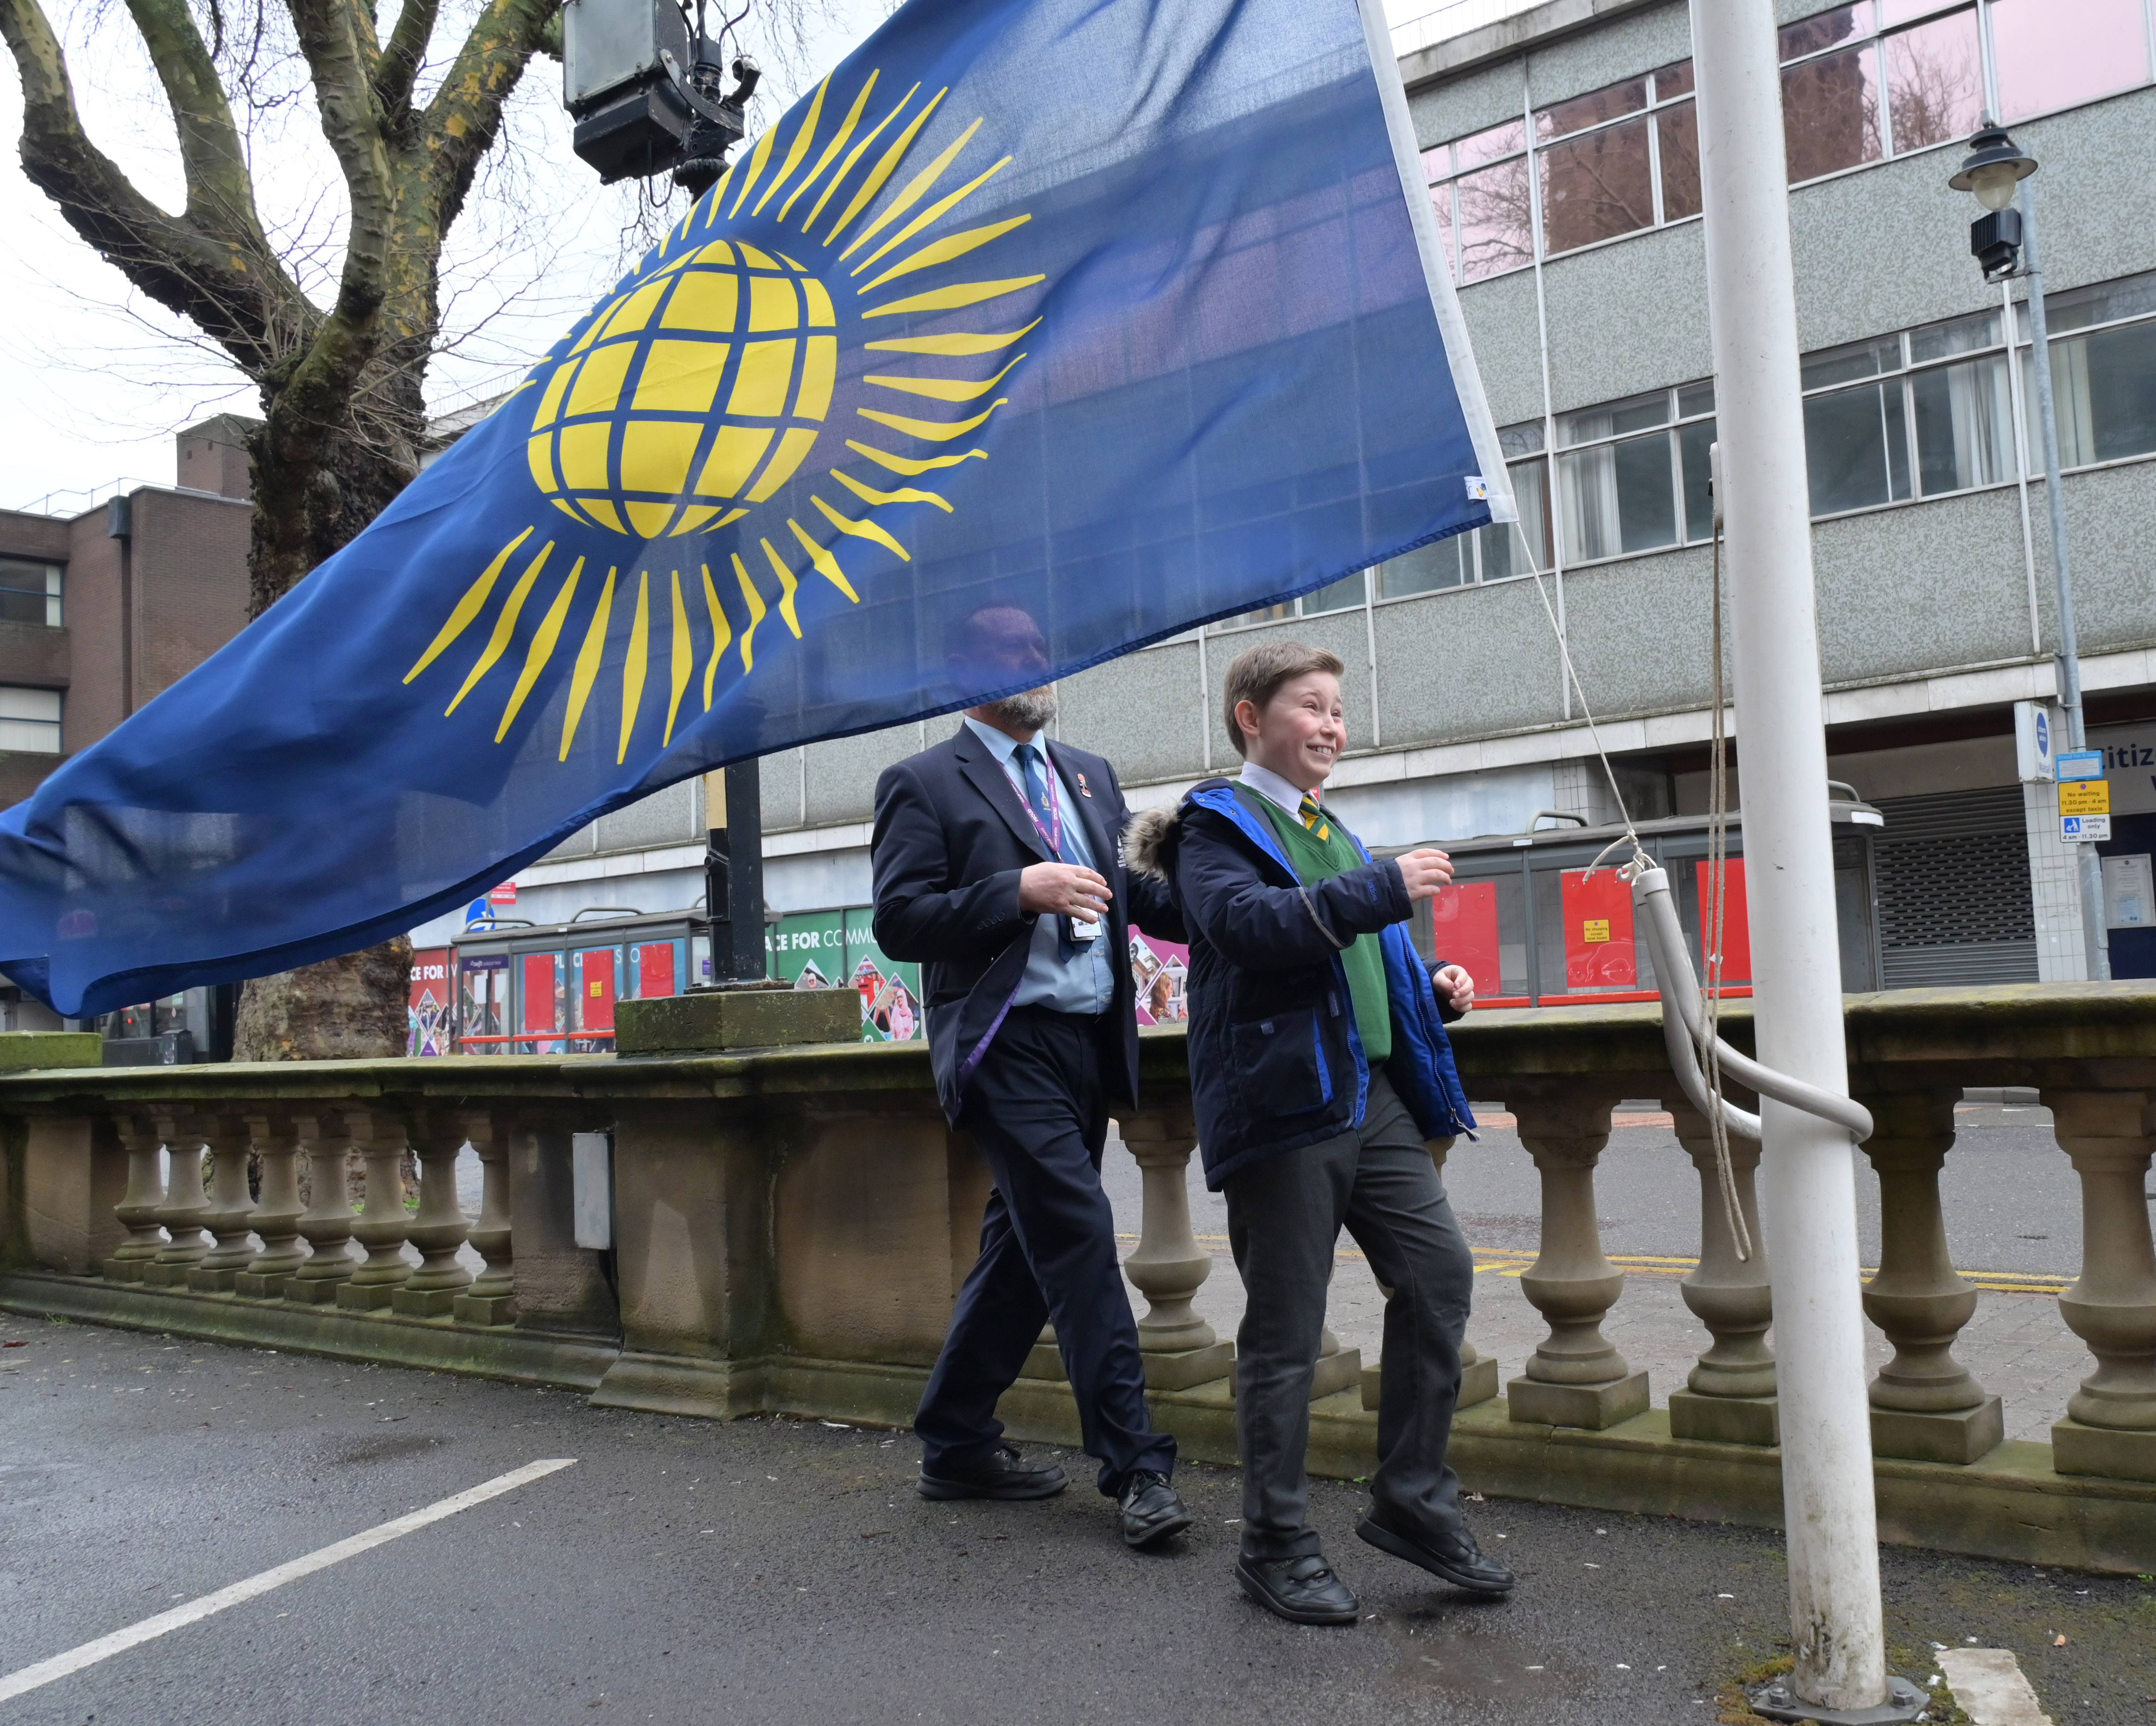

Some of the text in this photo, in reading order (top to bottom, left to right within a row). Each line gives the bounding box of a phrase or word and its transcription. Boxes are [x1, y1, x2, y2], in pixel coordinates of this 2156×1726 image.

[1028, 808, 1039, 822] PROUD
[792, 932, 820, 950] FOR
[423, 964, 444, 980] FOR
